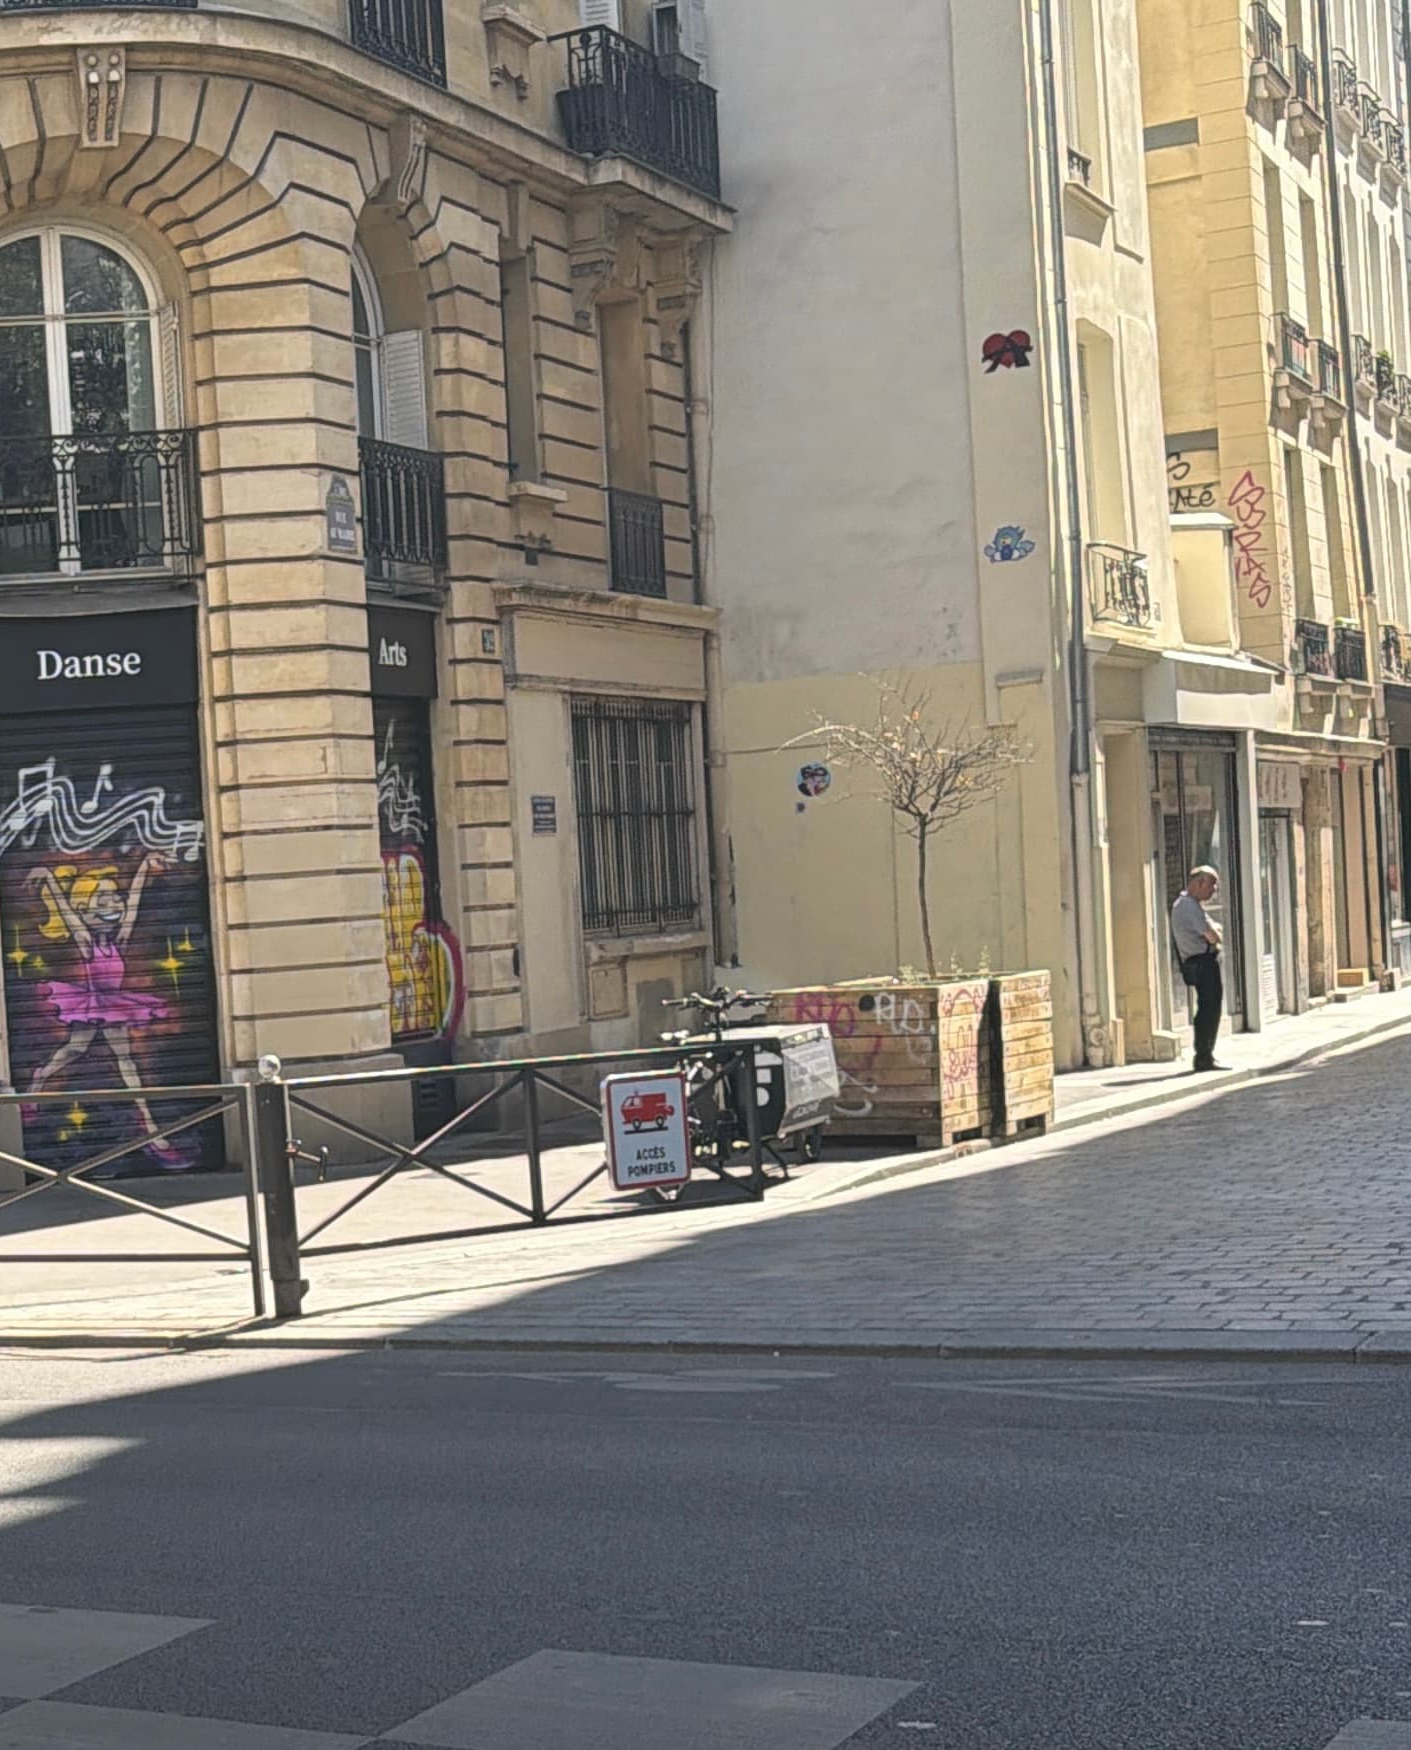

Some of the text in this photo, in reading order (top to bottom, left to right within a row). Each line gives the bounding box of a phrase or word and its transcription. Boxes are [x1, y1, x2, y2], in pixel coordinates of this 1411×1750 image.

[36, 650, 142, 681] Danse
[378, 637, 408, 667] Arts
[627, 1160, 676, 1178] POMPIERS
